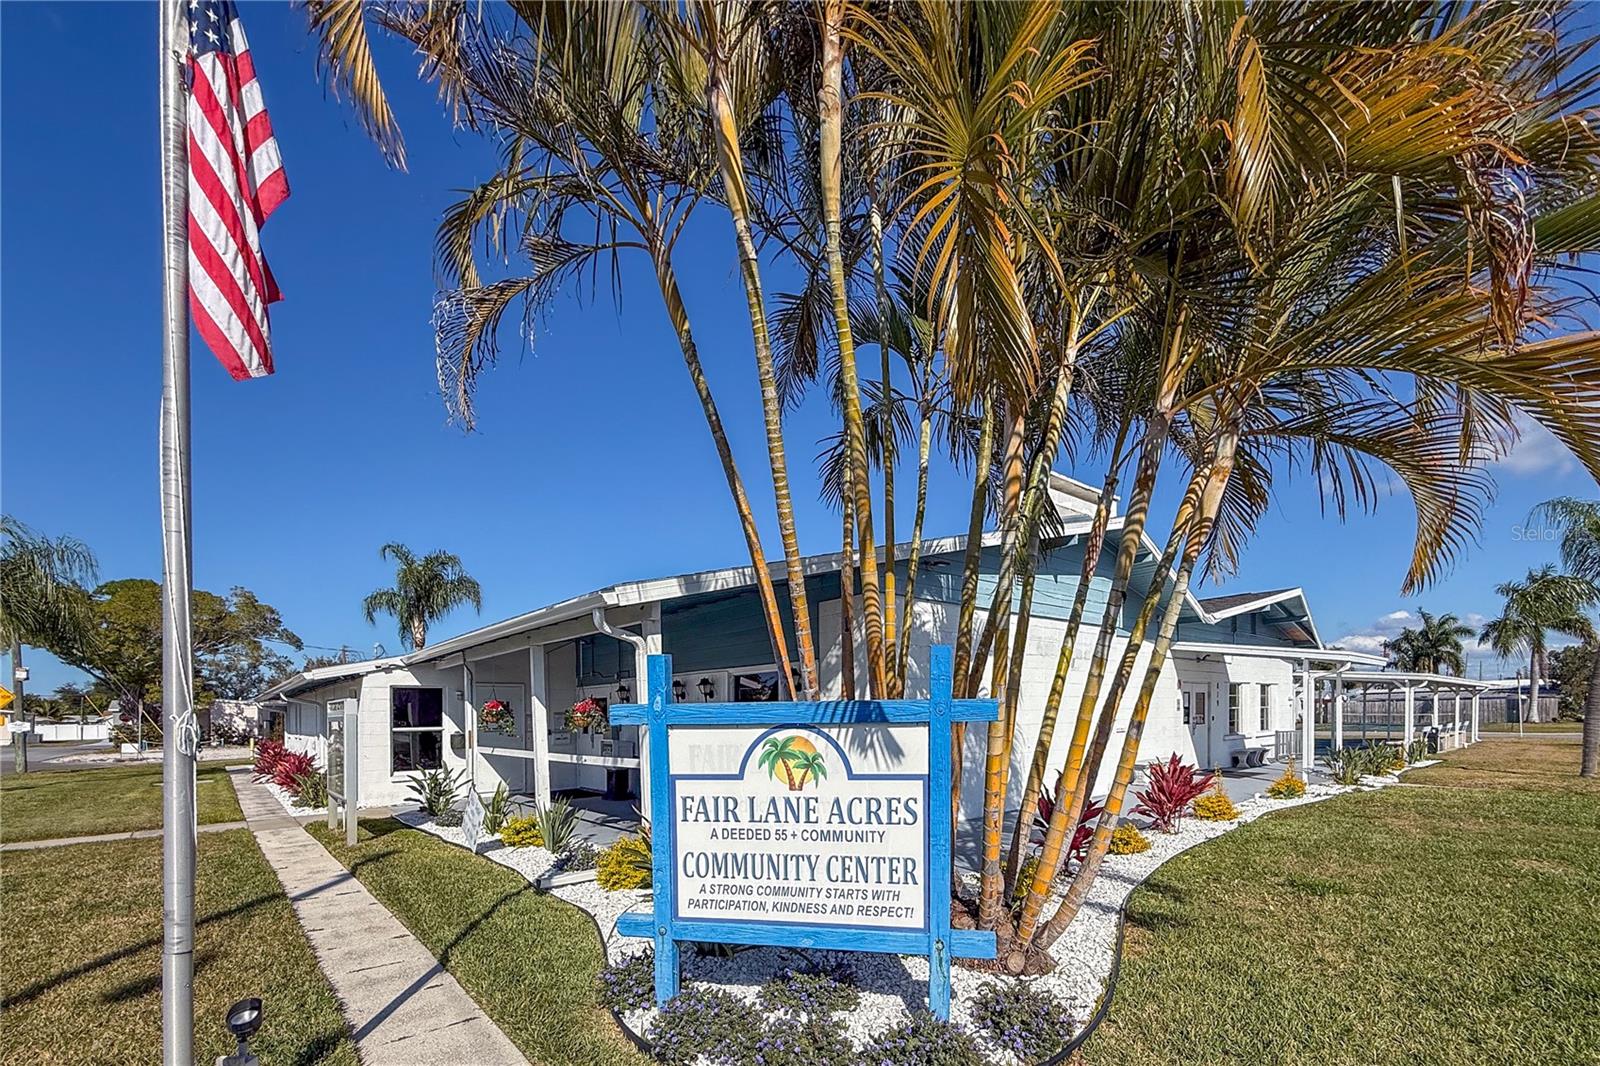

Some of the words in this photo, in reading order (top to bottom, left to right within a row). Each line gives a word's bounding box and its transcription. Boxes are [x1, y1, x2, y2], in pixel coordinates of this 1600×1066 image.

[681, 795, 741, 823] FAIR
[747, 796, 819, 824] LANE
[826, 796, 918, 826] ACRES
[710, 827, 719, 840] A
[721, 827, 771, 841] DEEDED
[774, 828, 788, 841] 55
[800, 828, 886, 843] COMMUNITY
[682, 851, 821, 883] COMMUNITY
[826, 855, 919, 886] CENTER
[698, 883, 707, 895] A
[709, 883, 754, 896] STRONG
[756, 885, 823, 899] COMMUNITY
[824, 887, 869, 900] STARTS
[871, 889, 901, 902] WITH
[687, 898, 769, 914] PARTICIPATION,
[771, 901, 828, 915] KINDNESS
[829, 903, 855, 916] AND
[856, 904, 915, 919] RESPECT!
